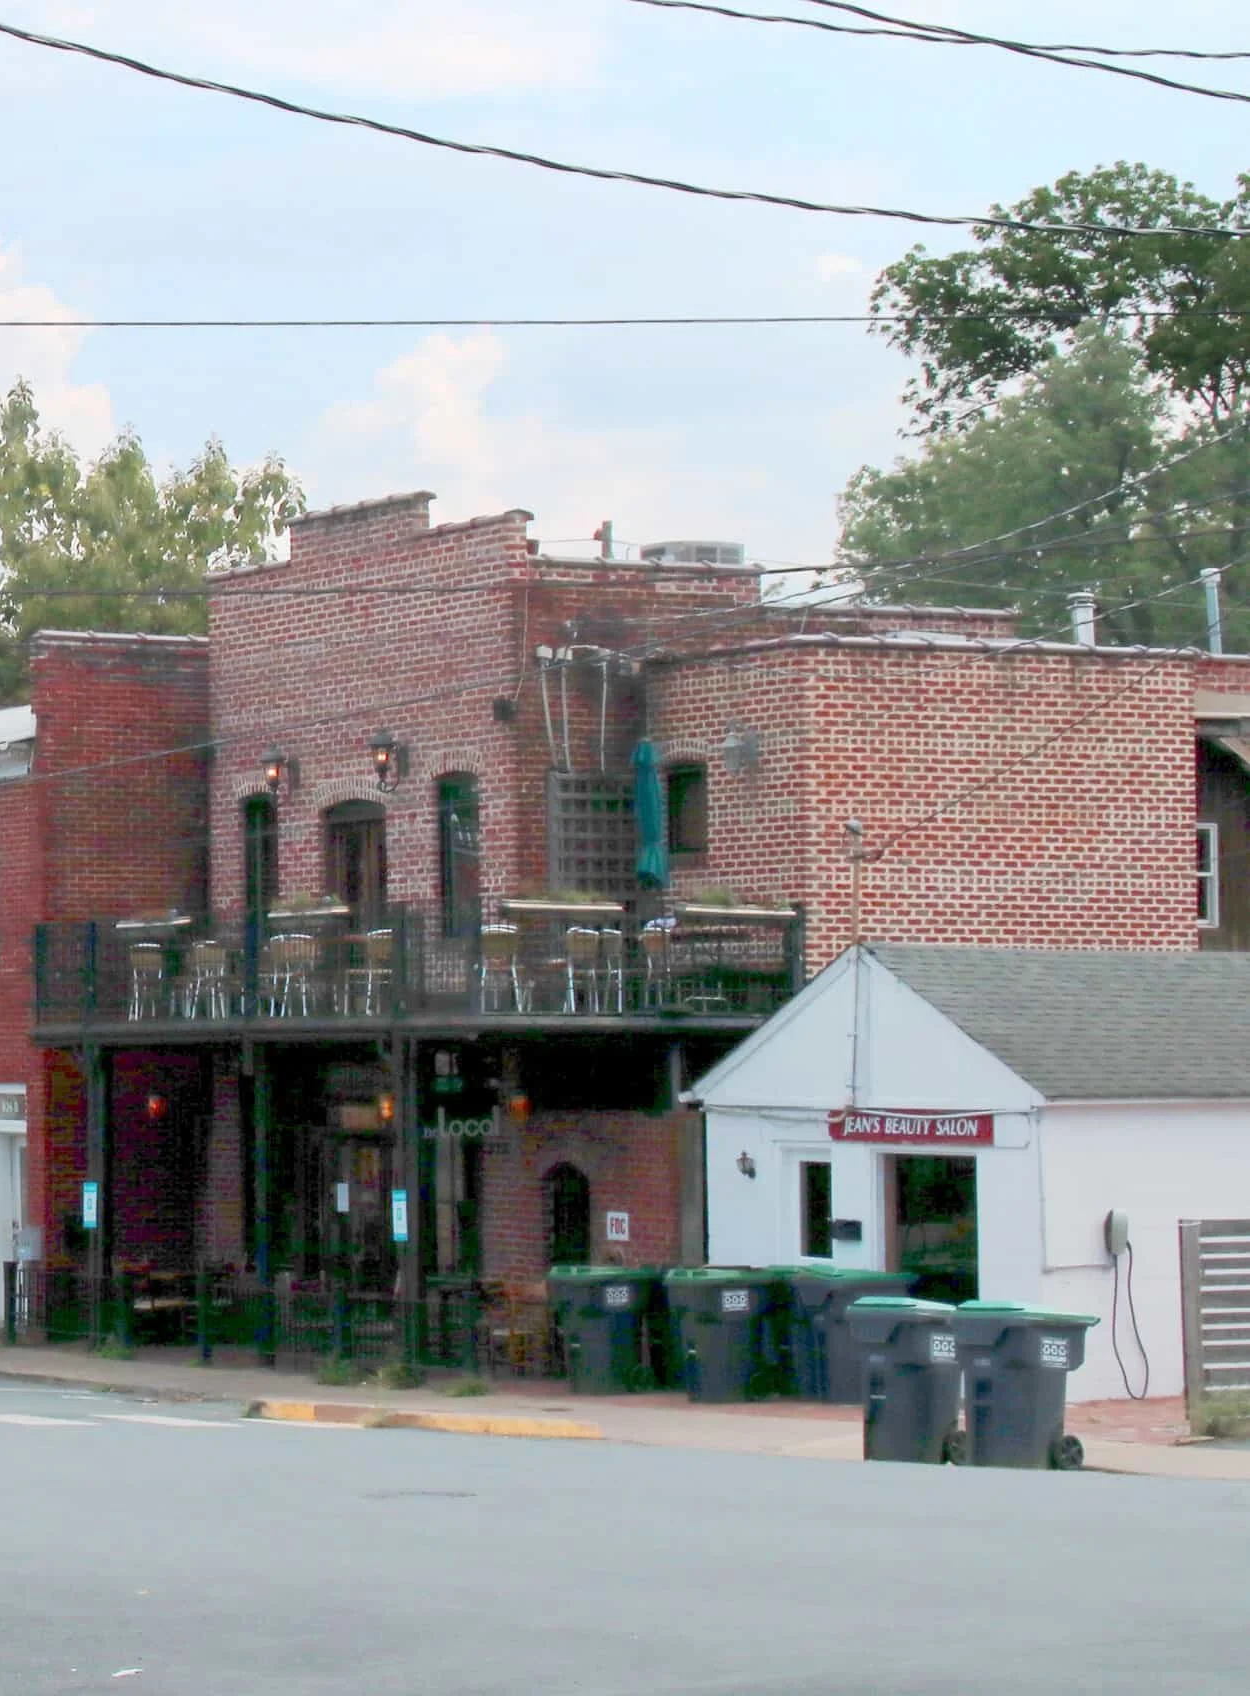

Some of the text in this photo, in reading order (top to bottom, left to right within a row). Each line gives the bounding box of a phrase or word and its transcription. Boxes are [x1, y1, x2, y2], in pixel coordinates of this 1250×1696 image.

[843, 1116, 979, 1137] JEAN'S BEAUTY SALON
